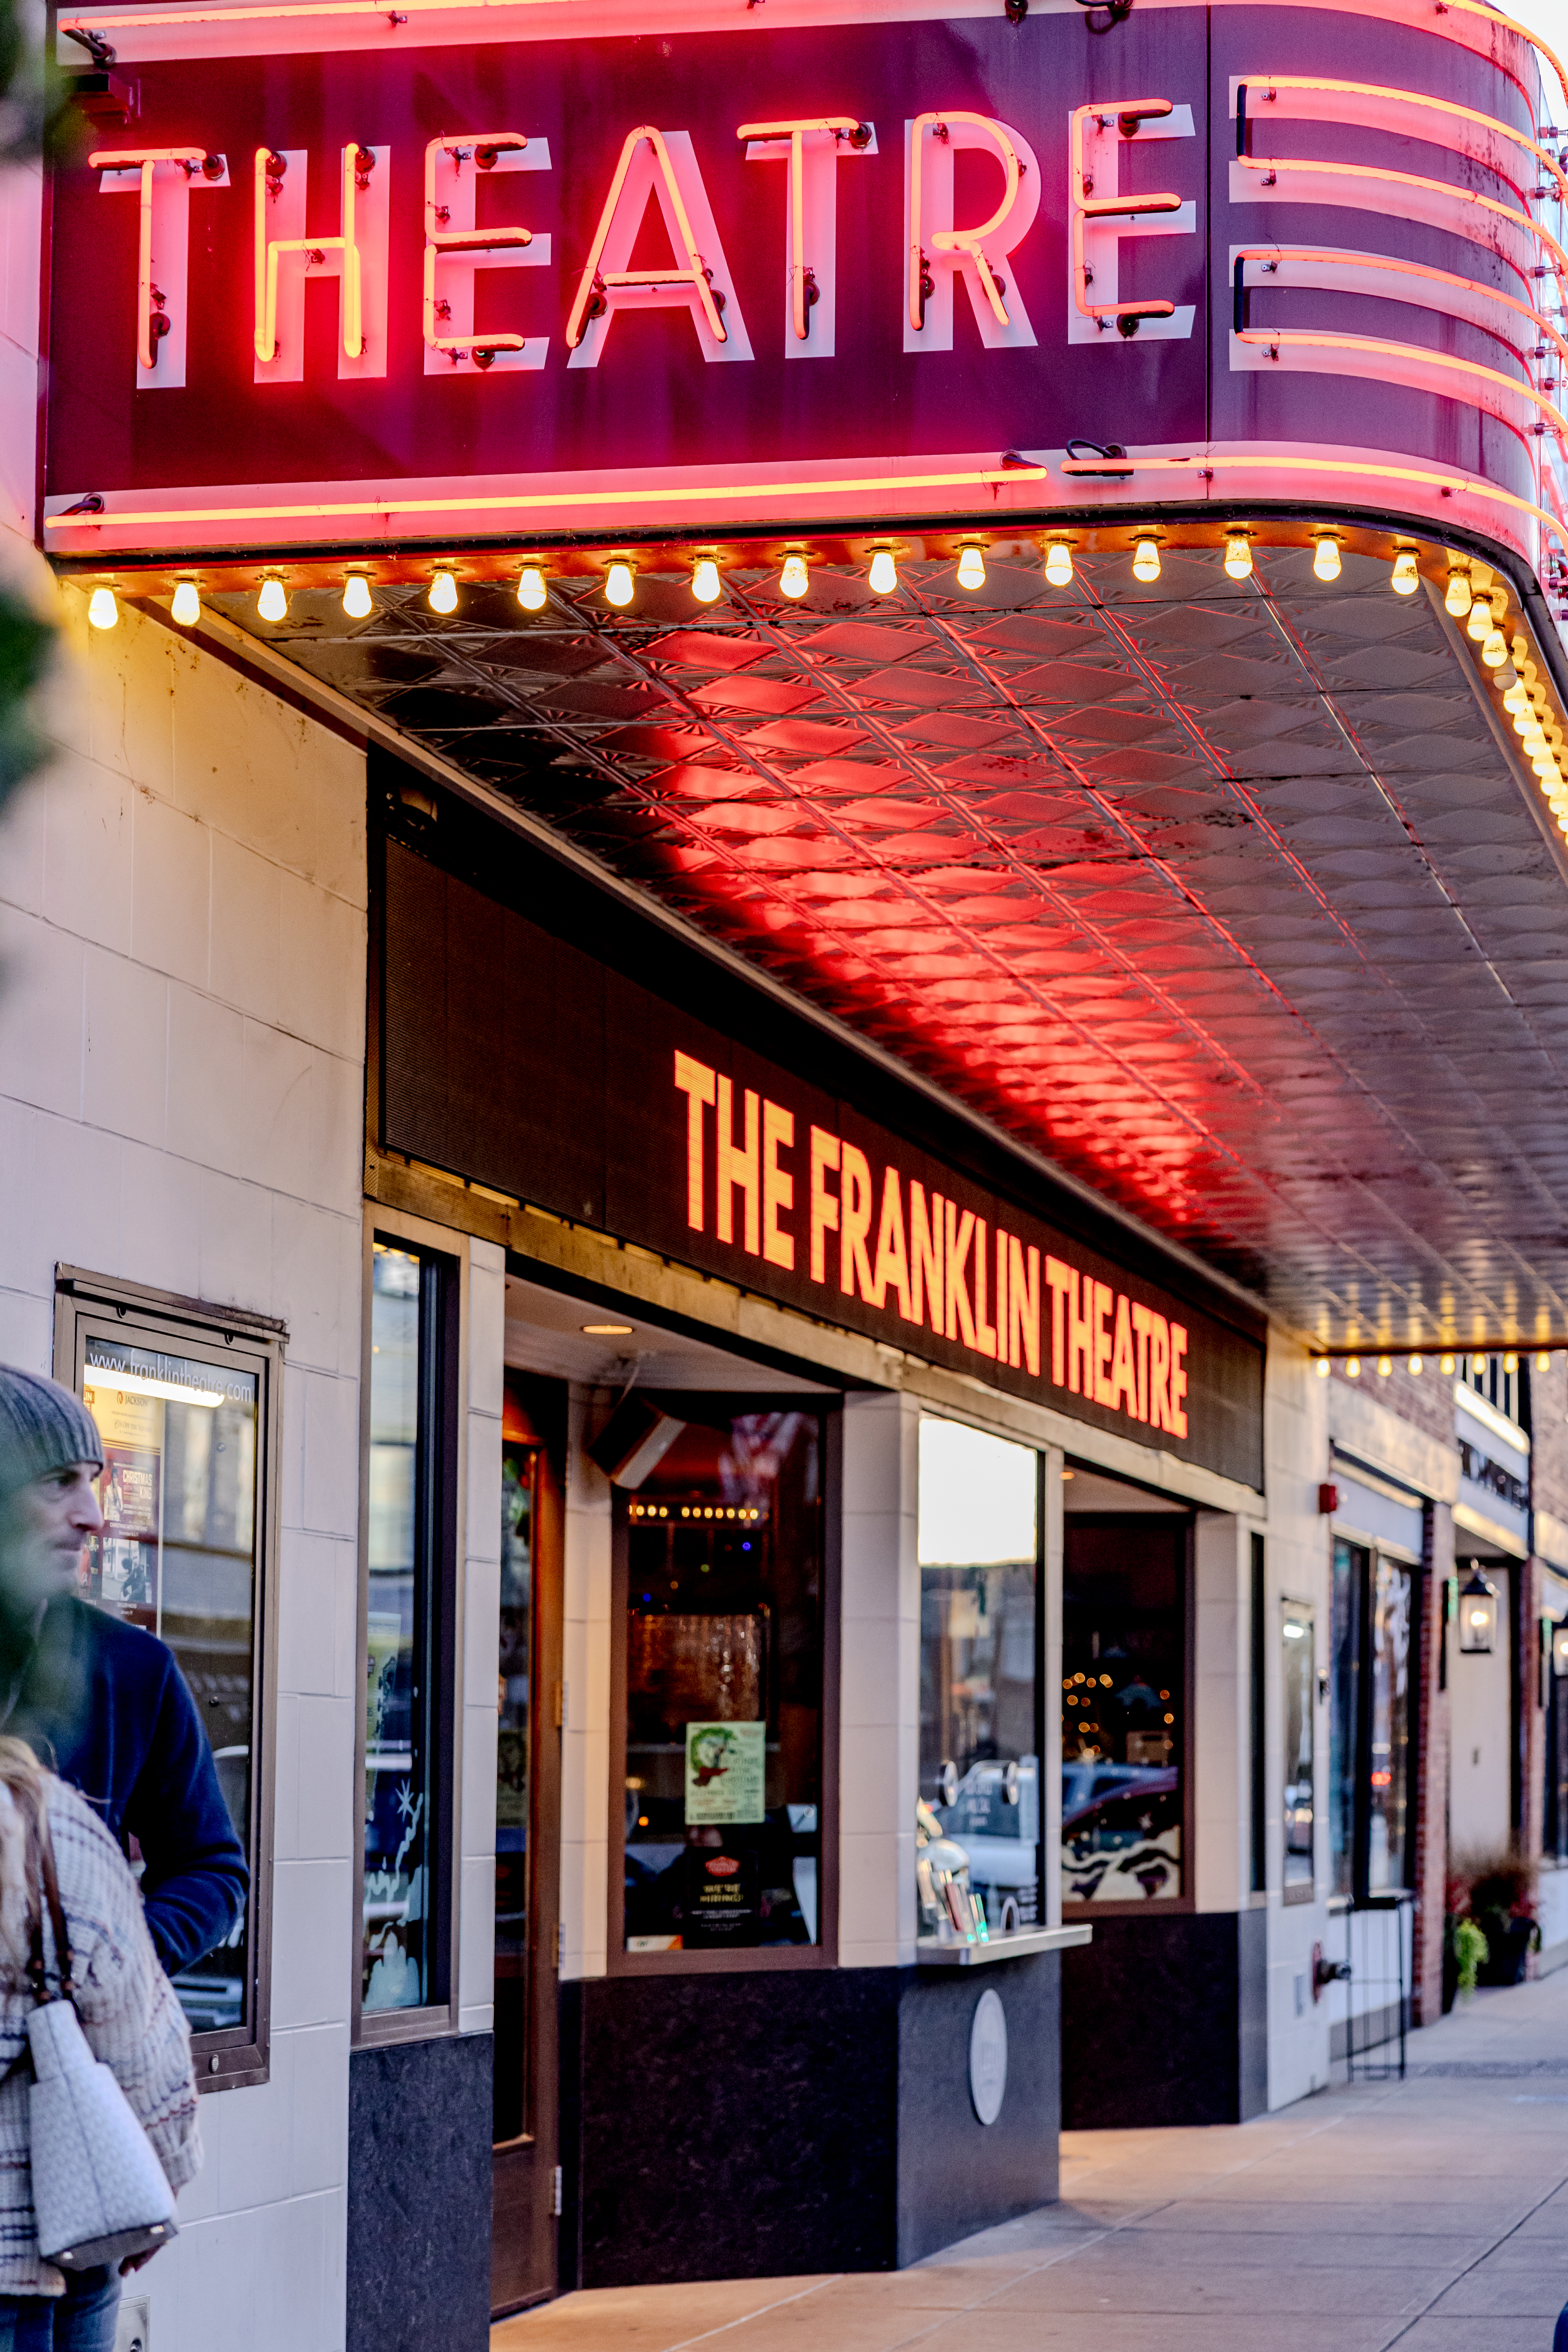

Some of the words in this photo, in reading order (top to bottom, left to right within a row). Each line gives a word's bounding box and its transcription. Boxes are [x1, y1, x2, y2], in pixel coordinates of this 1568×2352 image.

[87, 98, 1196, 391] THEATRE
[674, 1049, 795, 1271] THE
[810, 1124, 1040, 1377] FRANKLIN
[1045, 1254, 1188, 1439] THEATRE
[89, 1348, 252, 1403] wwwfranklintheatrecom
[125, 1394, 148, 1407] JACKSON
[123, 1469, 152, 1486] CHRISTMAS
[140, 1485, 152, 1500] KING
